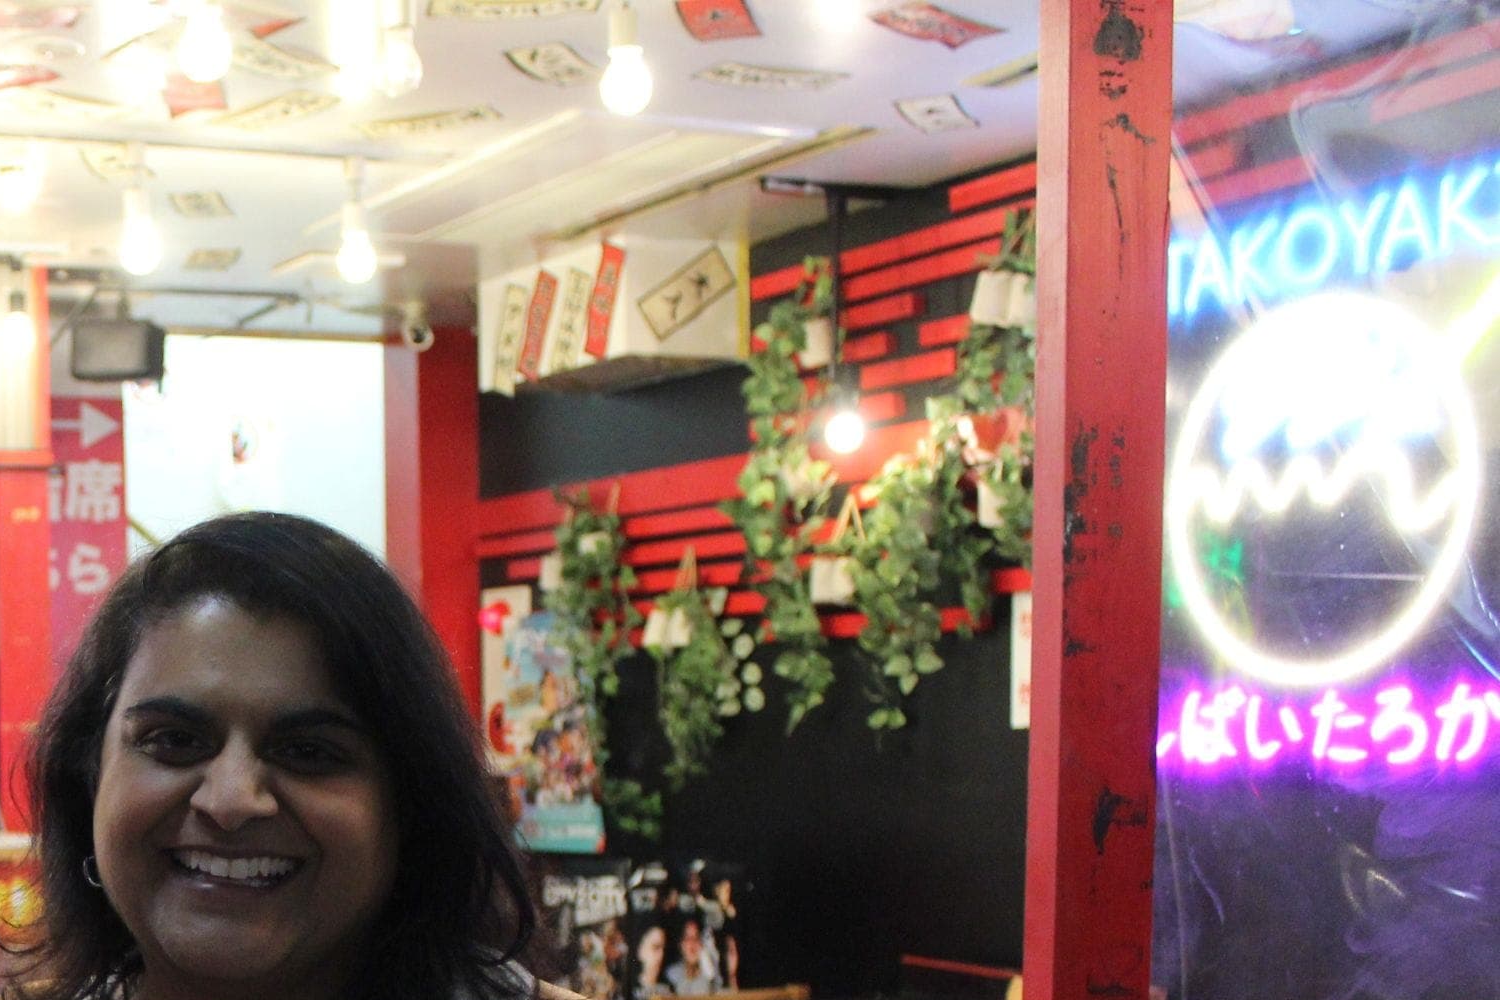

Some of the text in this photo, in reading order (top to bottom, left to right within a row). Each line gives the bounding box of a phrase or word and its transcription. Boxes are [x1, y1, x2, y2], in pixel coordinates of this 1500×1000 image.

[1167, 158, 1500, 315] TAKOYAK
[1155, 683, 1500, 764] ばいたろか
